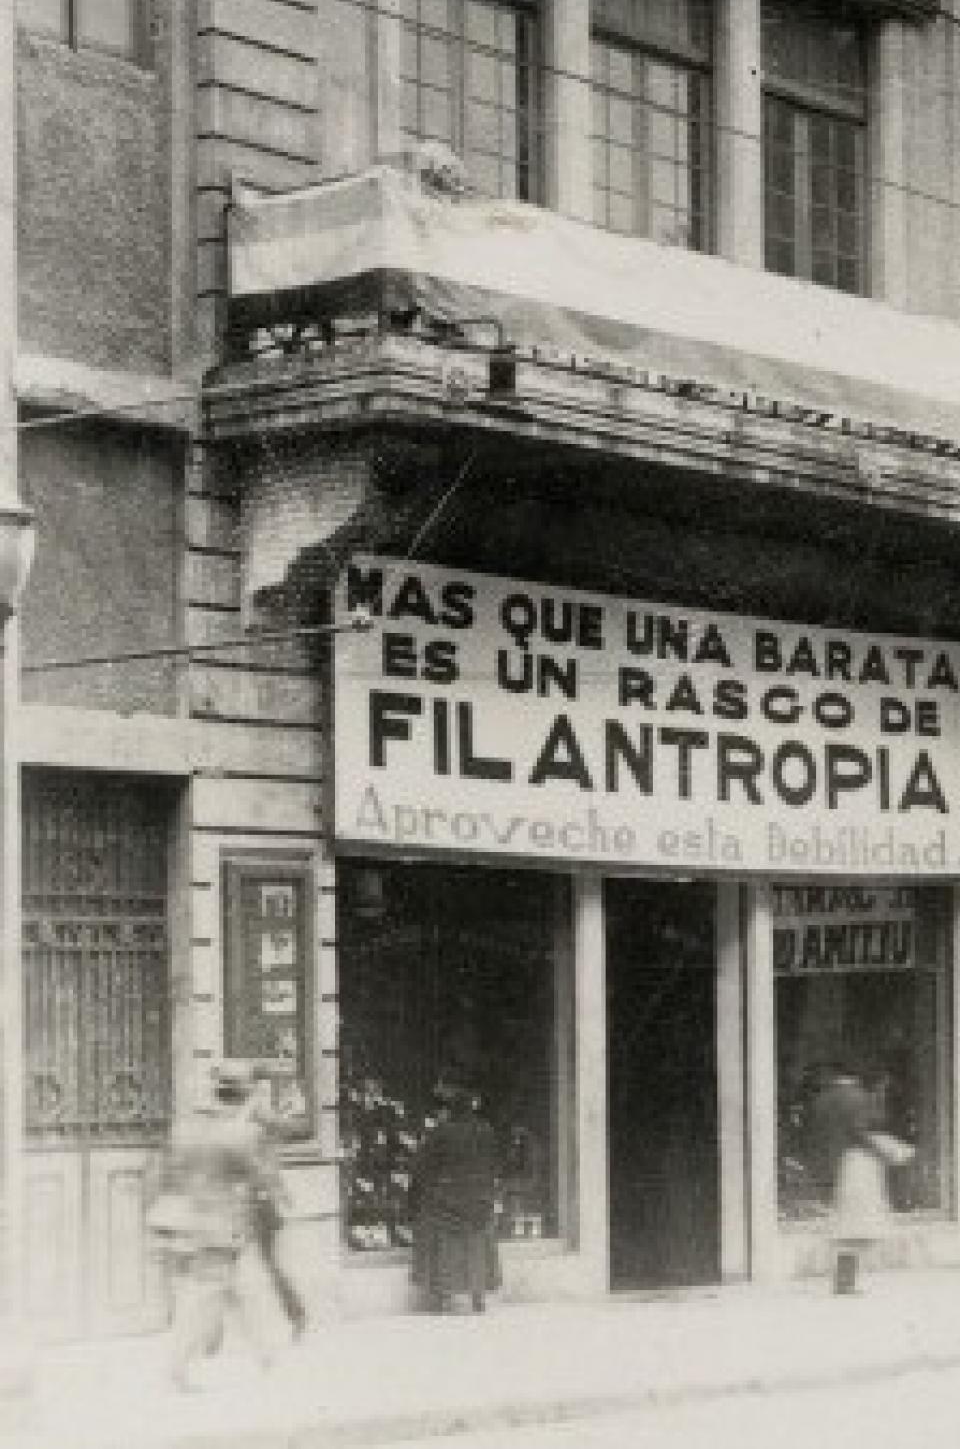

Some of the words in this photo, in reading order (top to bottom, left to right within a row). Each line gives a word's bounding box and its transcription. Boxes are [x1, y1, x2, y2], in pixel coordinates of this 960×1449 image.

[346, 564, 475, 630] MAS
[500, 592, 605, 650] QUE
[624, 610, 732, 668] UNA
[754, 629, 959, 693] BARATA
[381, 632, 460, 684] ES
[496, 648, 578, 702] UN
[879, 695, 942, 738] DE
[367, 688, 951, 814] FILANTROPIA
[355, 783, 637, 857] Aproveche
[656, 818, 742, 864] esta
